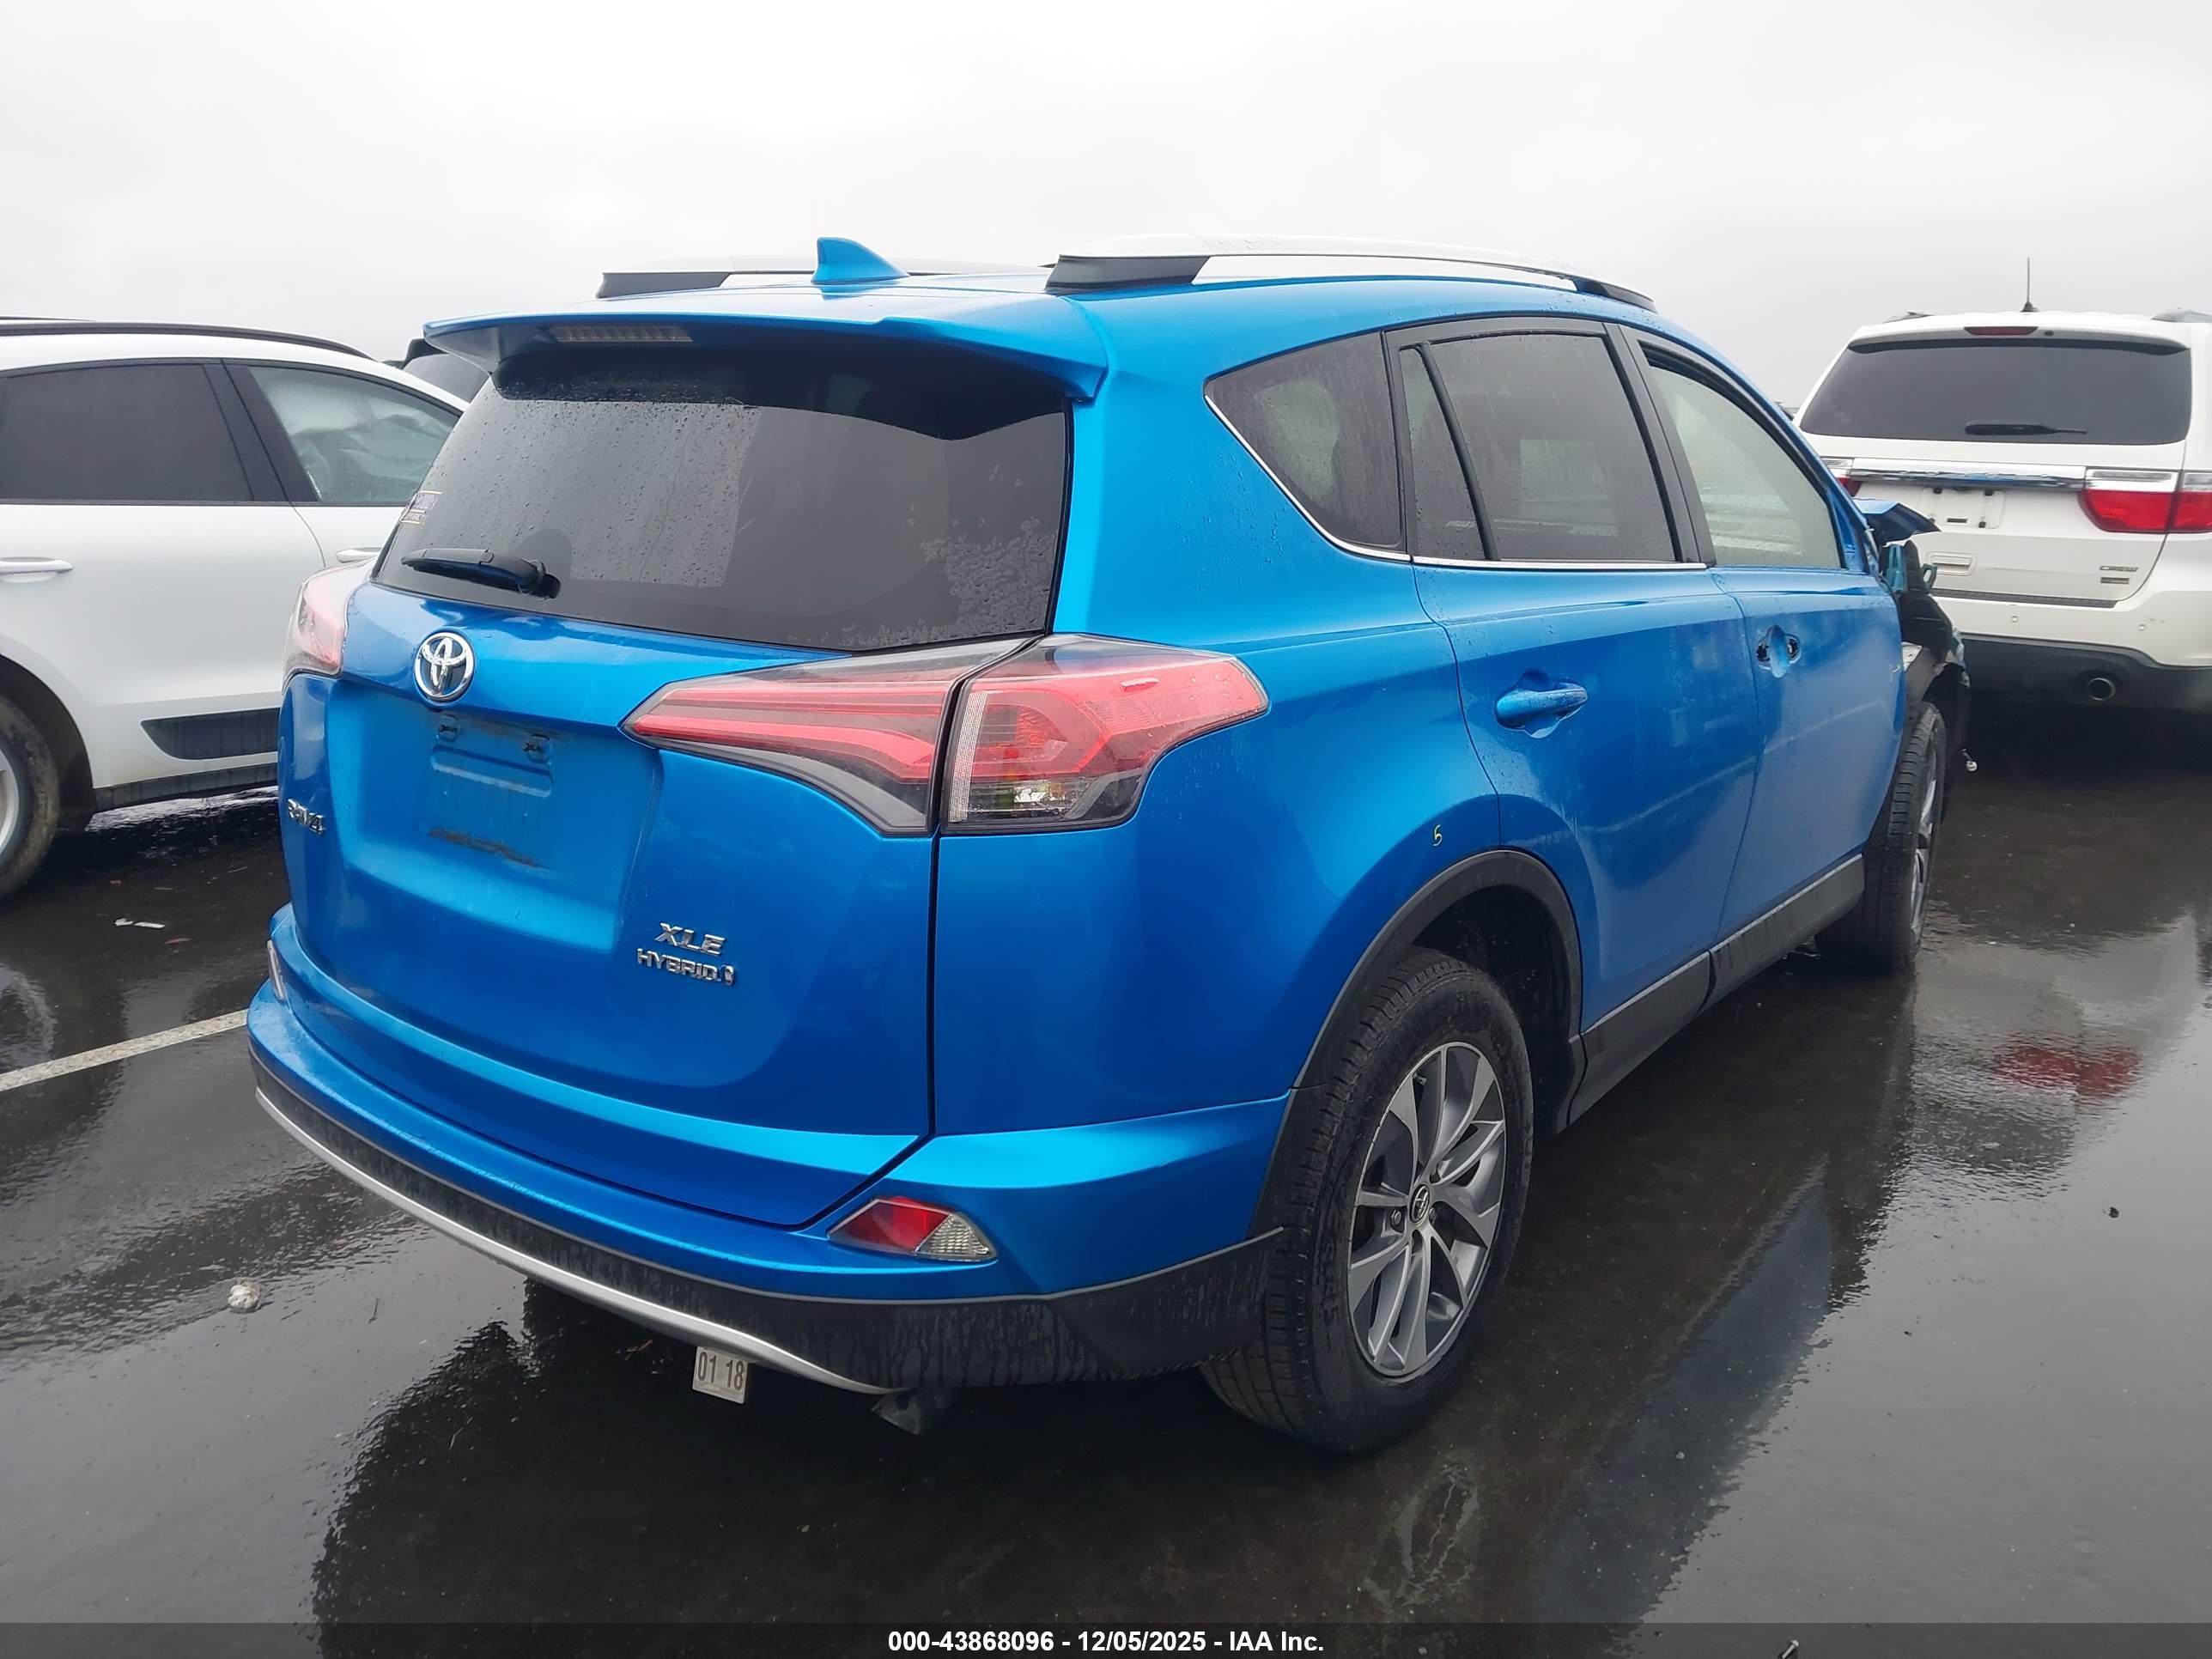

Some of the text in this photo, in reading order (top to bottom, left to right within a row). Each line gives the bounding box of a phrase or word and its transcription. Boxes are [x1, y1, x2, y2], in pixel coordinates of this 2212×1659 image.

[654, 921, 726, 956] XLE
[636, 947, 718, 981] HYBRID
[697, 1351, 744, 1391] 01 18
